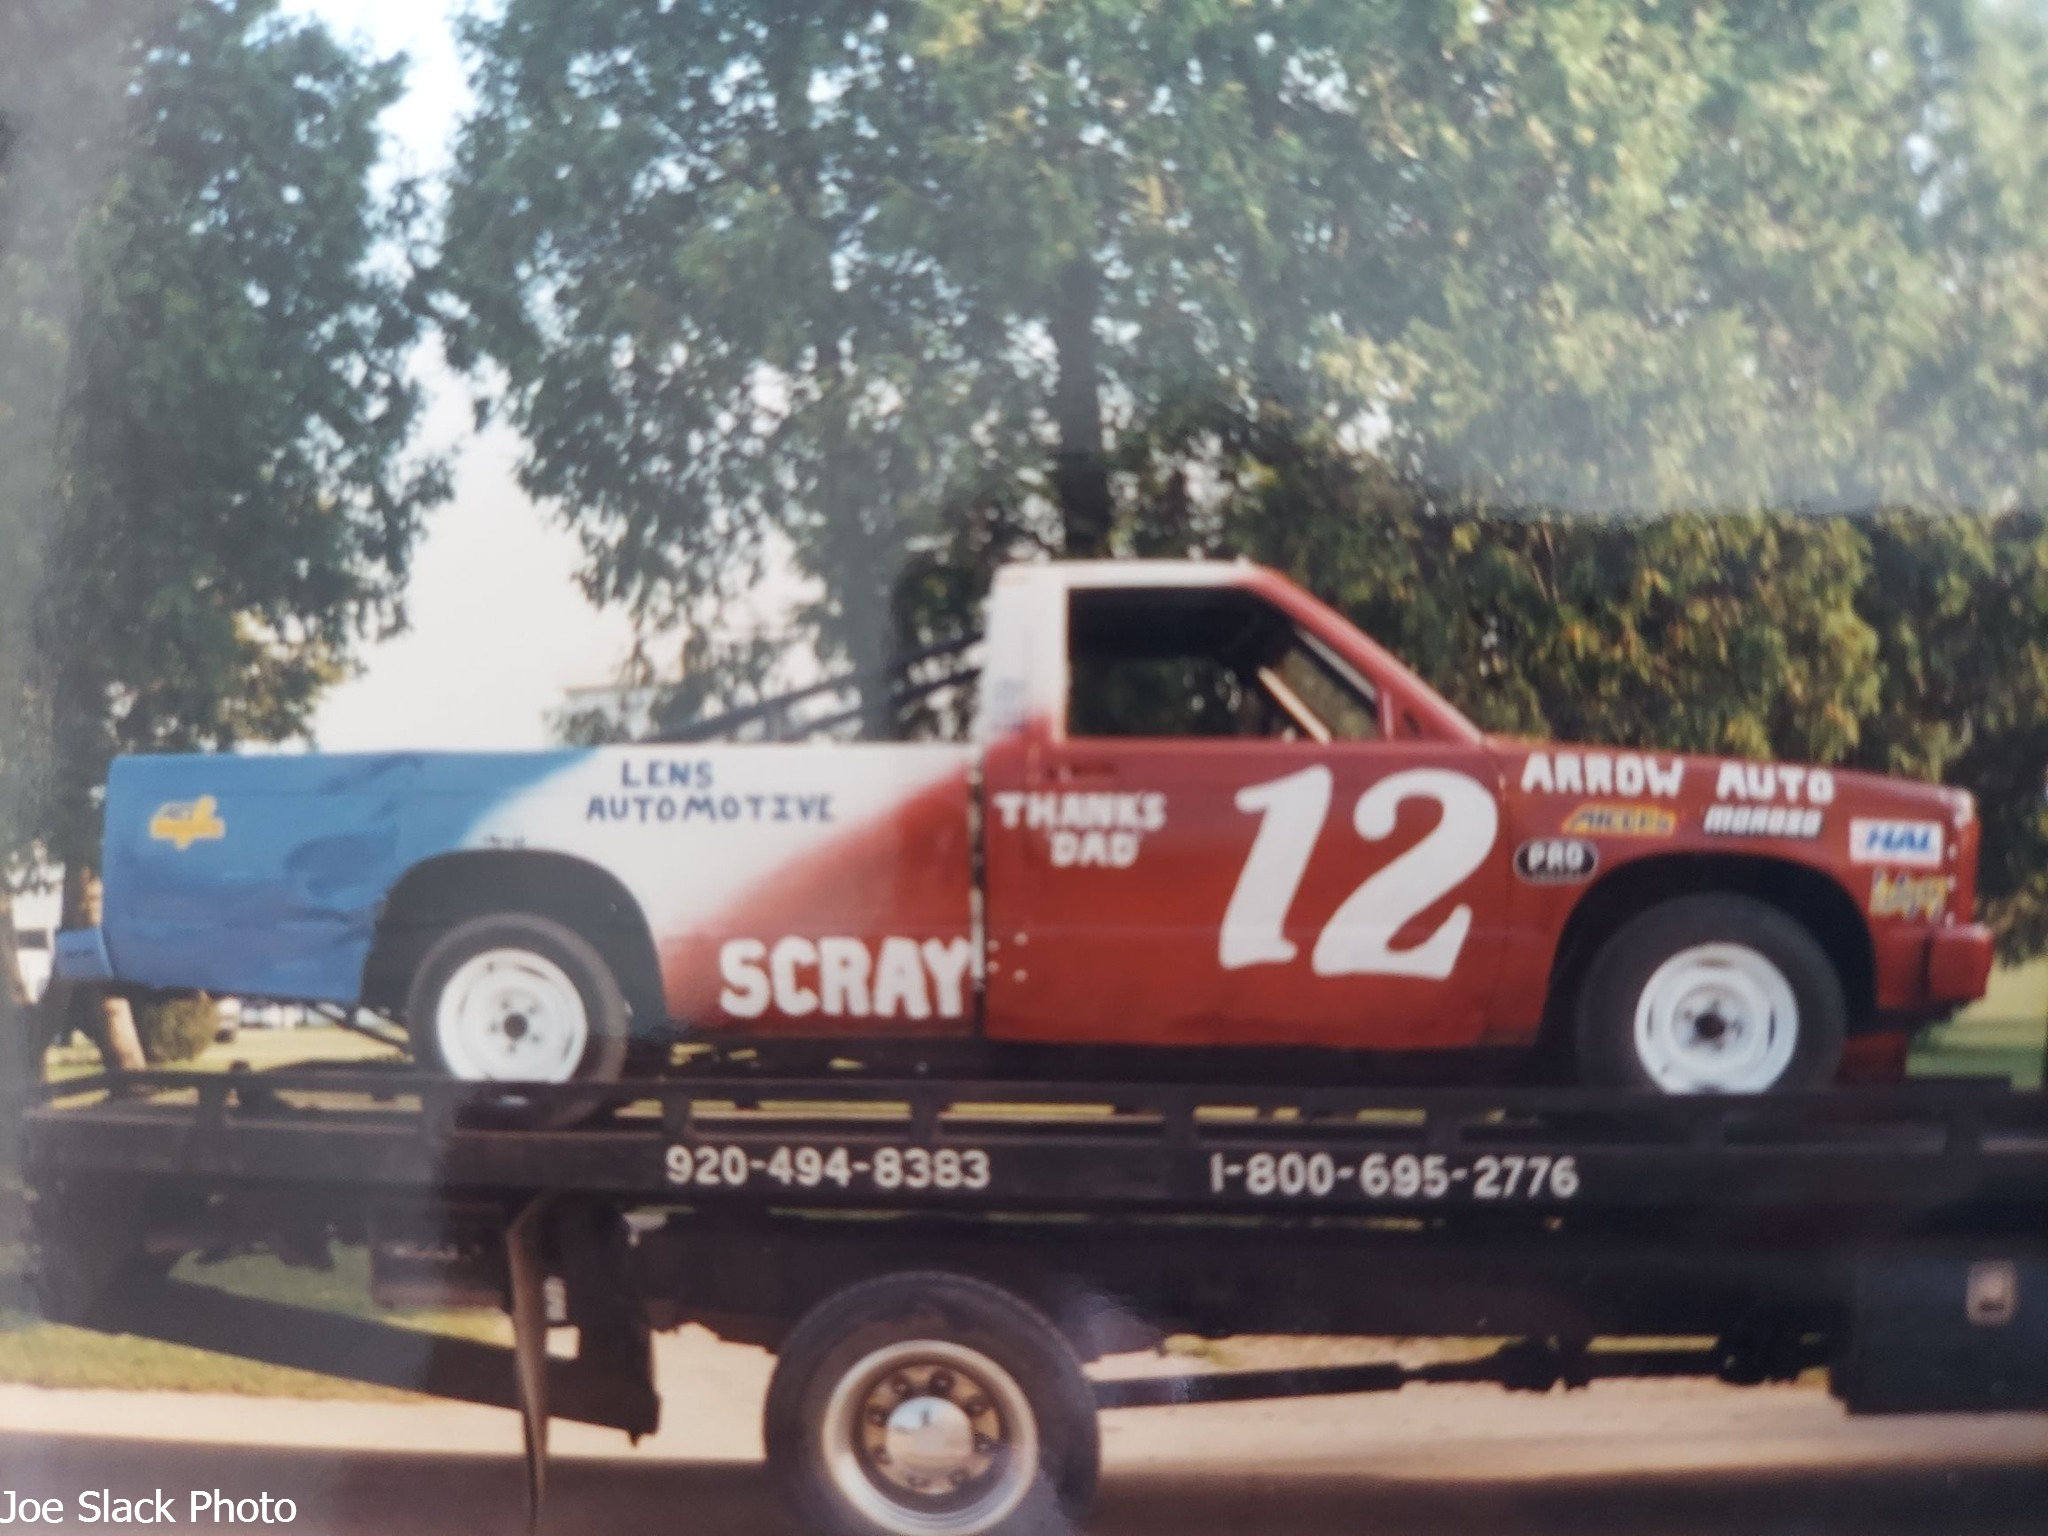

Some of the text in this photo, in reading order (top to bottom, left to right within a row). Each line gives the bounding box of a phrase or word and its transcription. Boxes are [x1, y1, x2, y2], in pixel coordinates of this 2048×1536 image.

[621, 760, 714, 788] LENS
[1520, 752, 1835, 805] ARROW AUTO
[586, 795, 836, 822] AUTOMOTIVE
[1219, 764, 1498, 981] 12
[1527, 840, 1585, 872] PRO
[720, 936, 973, 1019] SCRAY
[664, 1145, 992, 1189] 920-494-8383
[1209, 1152, 1580, 1199] 1-800-695-2776
